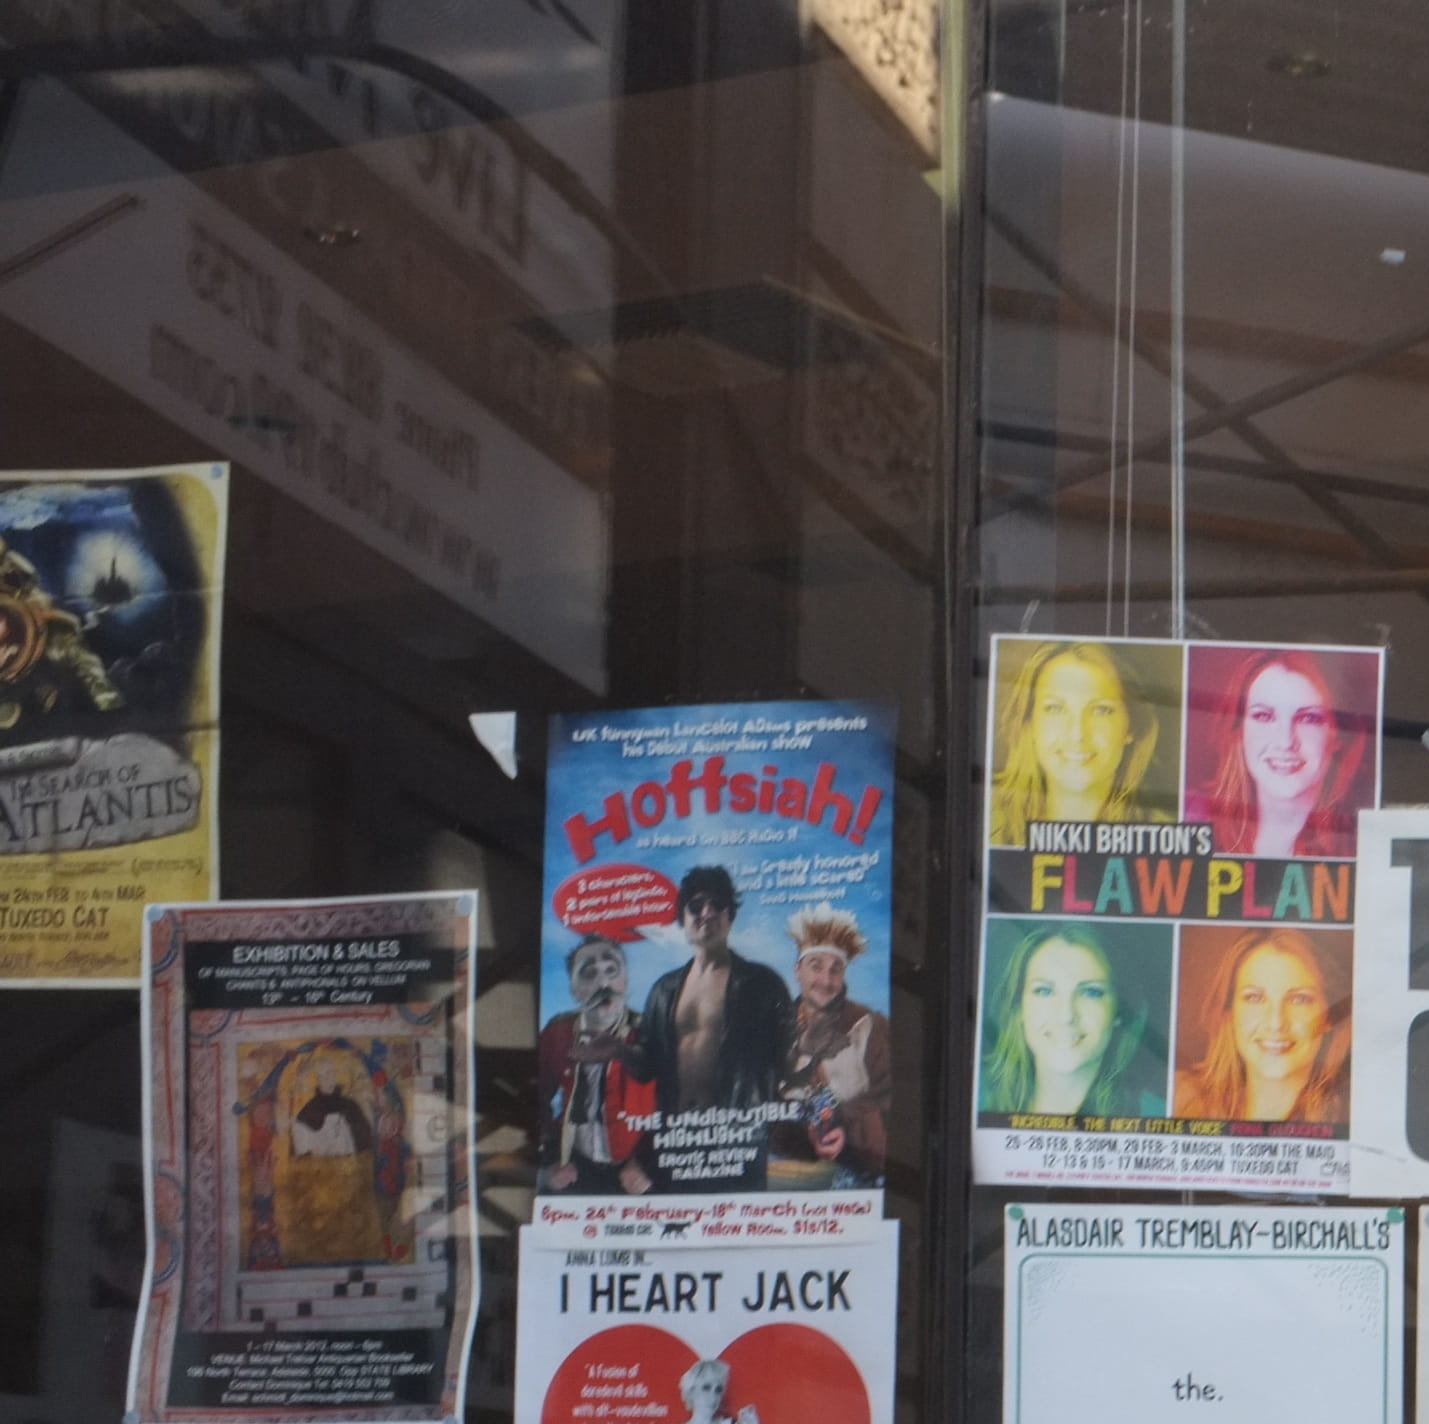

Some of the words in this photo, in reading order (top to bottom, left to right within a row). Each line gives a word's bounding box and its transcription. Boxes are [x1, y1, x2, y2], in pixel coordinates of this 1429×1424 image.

[564, 755, 883, 864] Hoffsiah!
[1029, 822, 1092, 854] NIKKI
[1096, 824, 1213, 857] BRITTON'S
[1030, 853, 1194, 917] FLAW
[1207, 859, 1351, 921] PLAN
[232, 944, 329, 964] EXHIBITION
[348, 940, 400, 959] SALES
[1016, 1217, 1125, 1249] ALASDAIR
[590, 1271, 723, 1313] HEART
[742, 1269, 853, 1312] JACK
